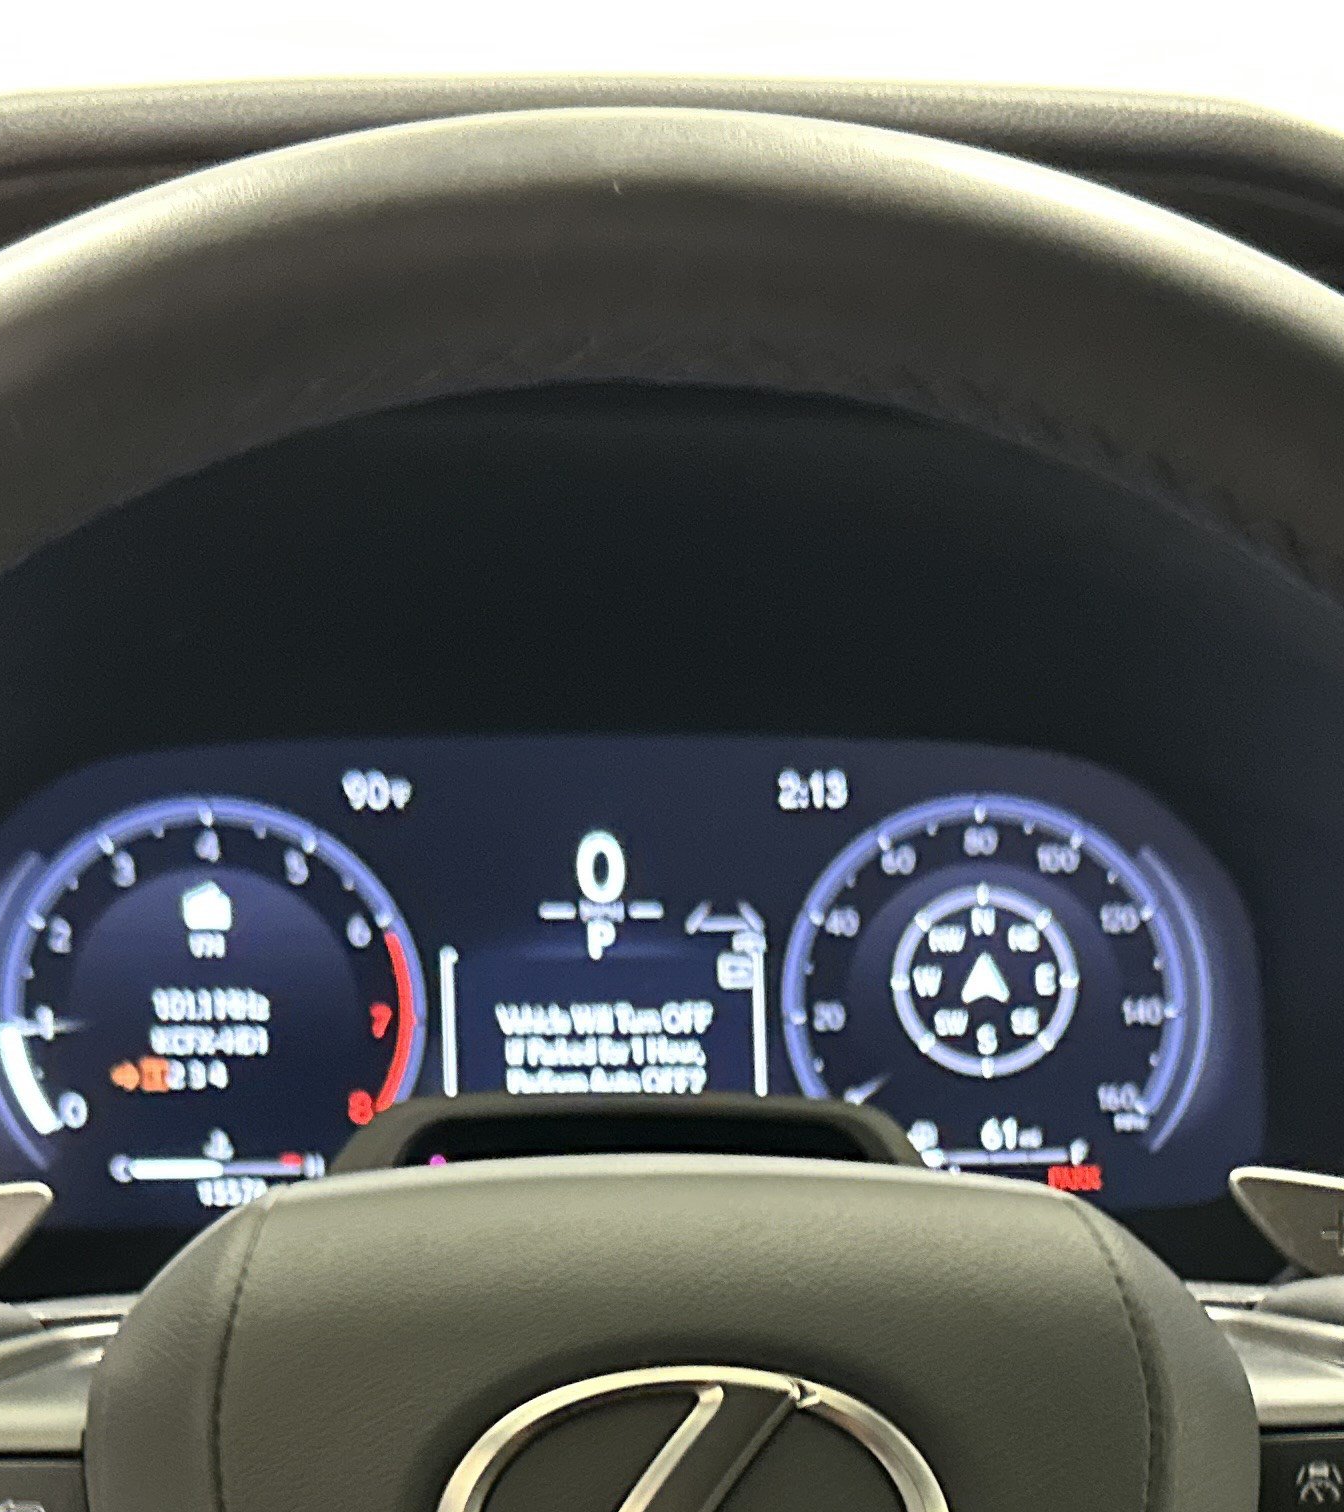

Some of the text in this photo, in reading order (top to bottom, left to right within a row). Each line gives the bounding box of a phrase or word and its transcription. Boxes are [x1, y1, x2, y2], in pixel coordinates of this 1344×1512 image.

[777, 768, 850, 811] 2:13
[963, 825, 999, 856] 80
[576, 829, 627, 904] 0
[1037, 843, 1081, 874] 100
[824, 905, 860, 938] 40
[970, 906, 996, 937] N
[1099, 902, 1141, 934] 120
[587, 918, 617, 961] P
[912, 963, 943, 998] W
[812, 1001, 847, 1032] 20
[1122, 995, 1164, 1026] 140
[975, 1022, 999, 1056] S
[58, 1090, 88, 1130] 0
[347, 1089, 374, 1126] 8
